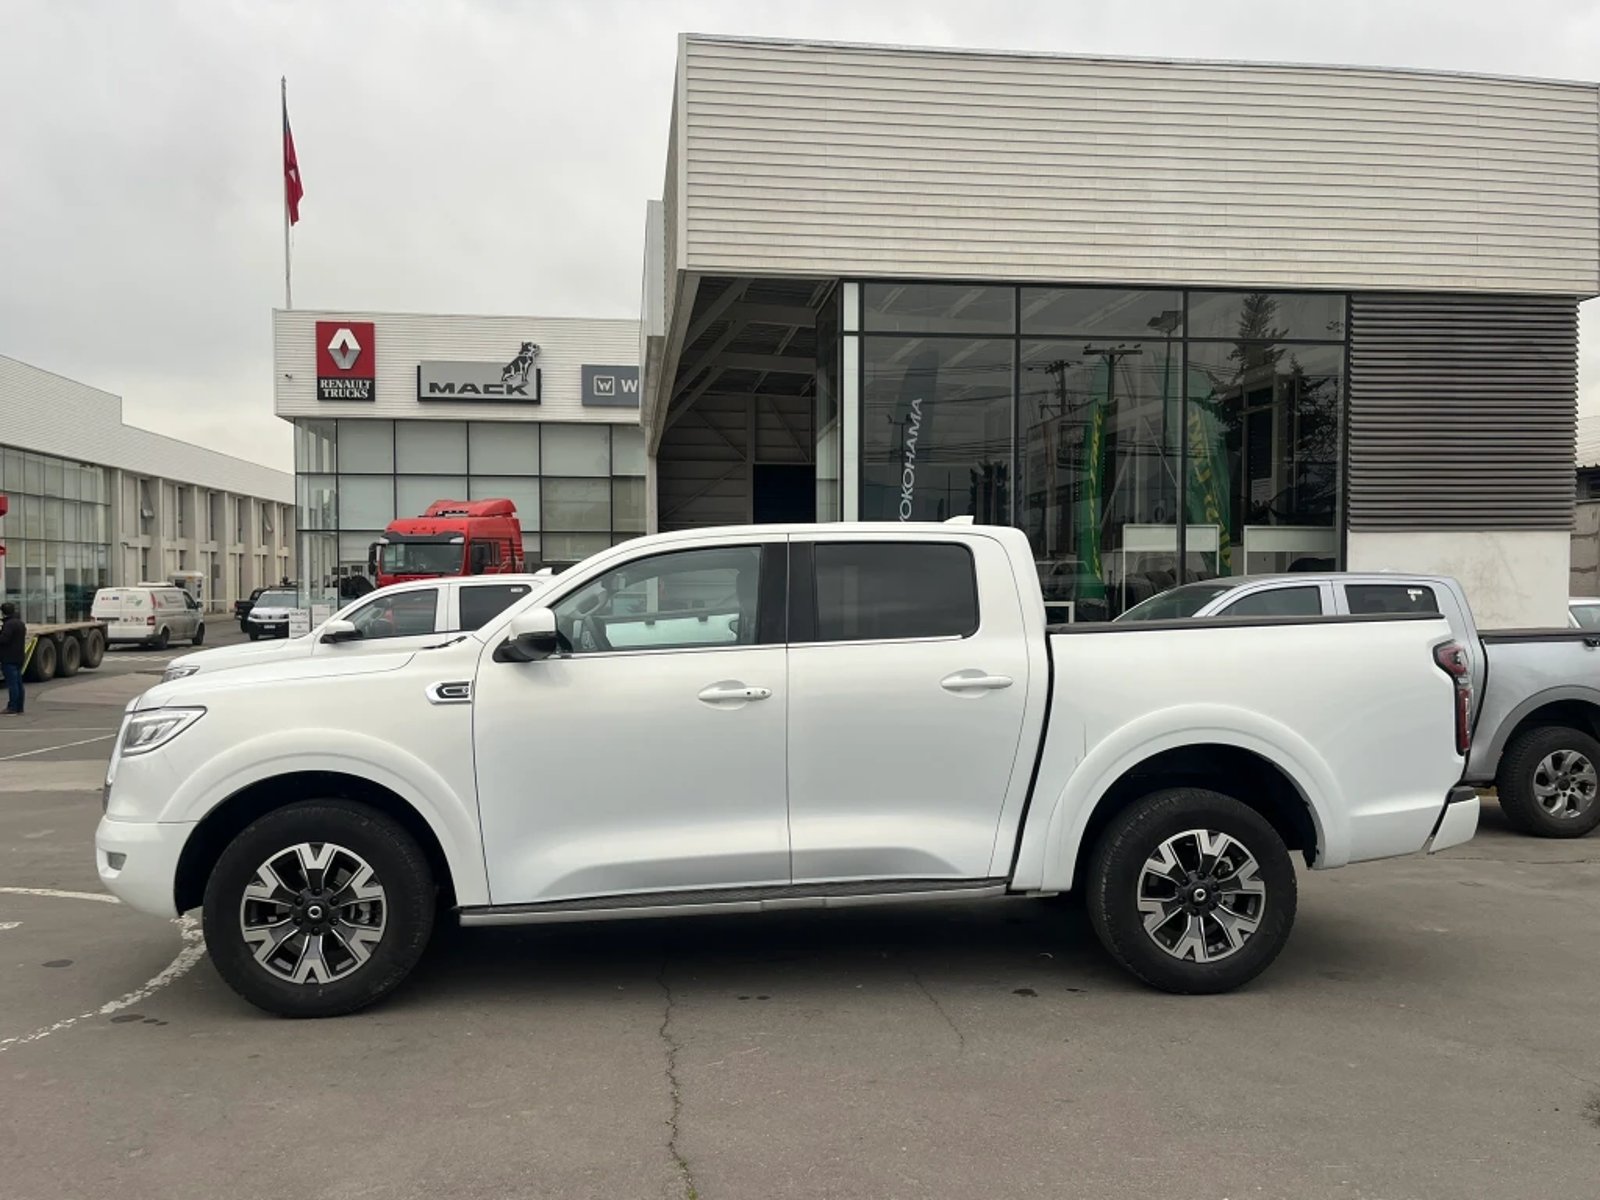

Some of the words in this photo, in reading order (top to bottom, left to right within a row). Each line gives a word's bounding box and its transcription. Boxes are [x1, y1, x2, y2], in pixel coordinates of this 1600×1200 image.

[320, 379, 372, 389] RENAULT
[429, 382, 528, 396] MACK
[323, 388, 368, 398] TRUCKS
